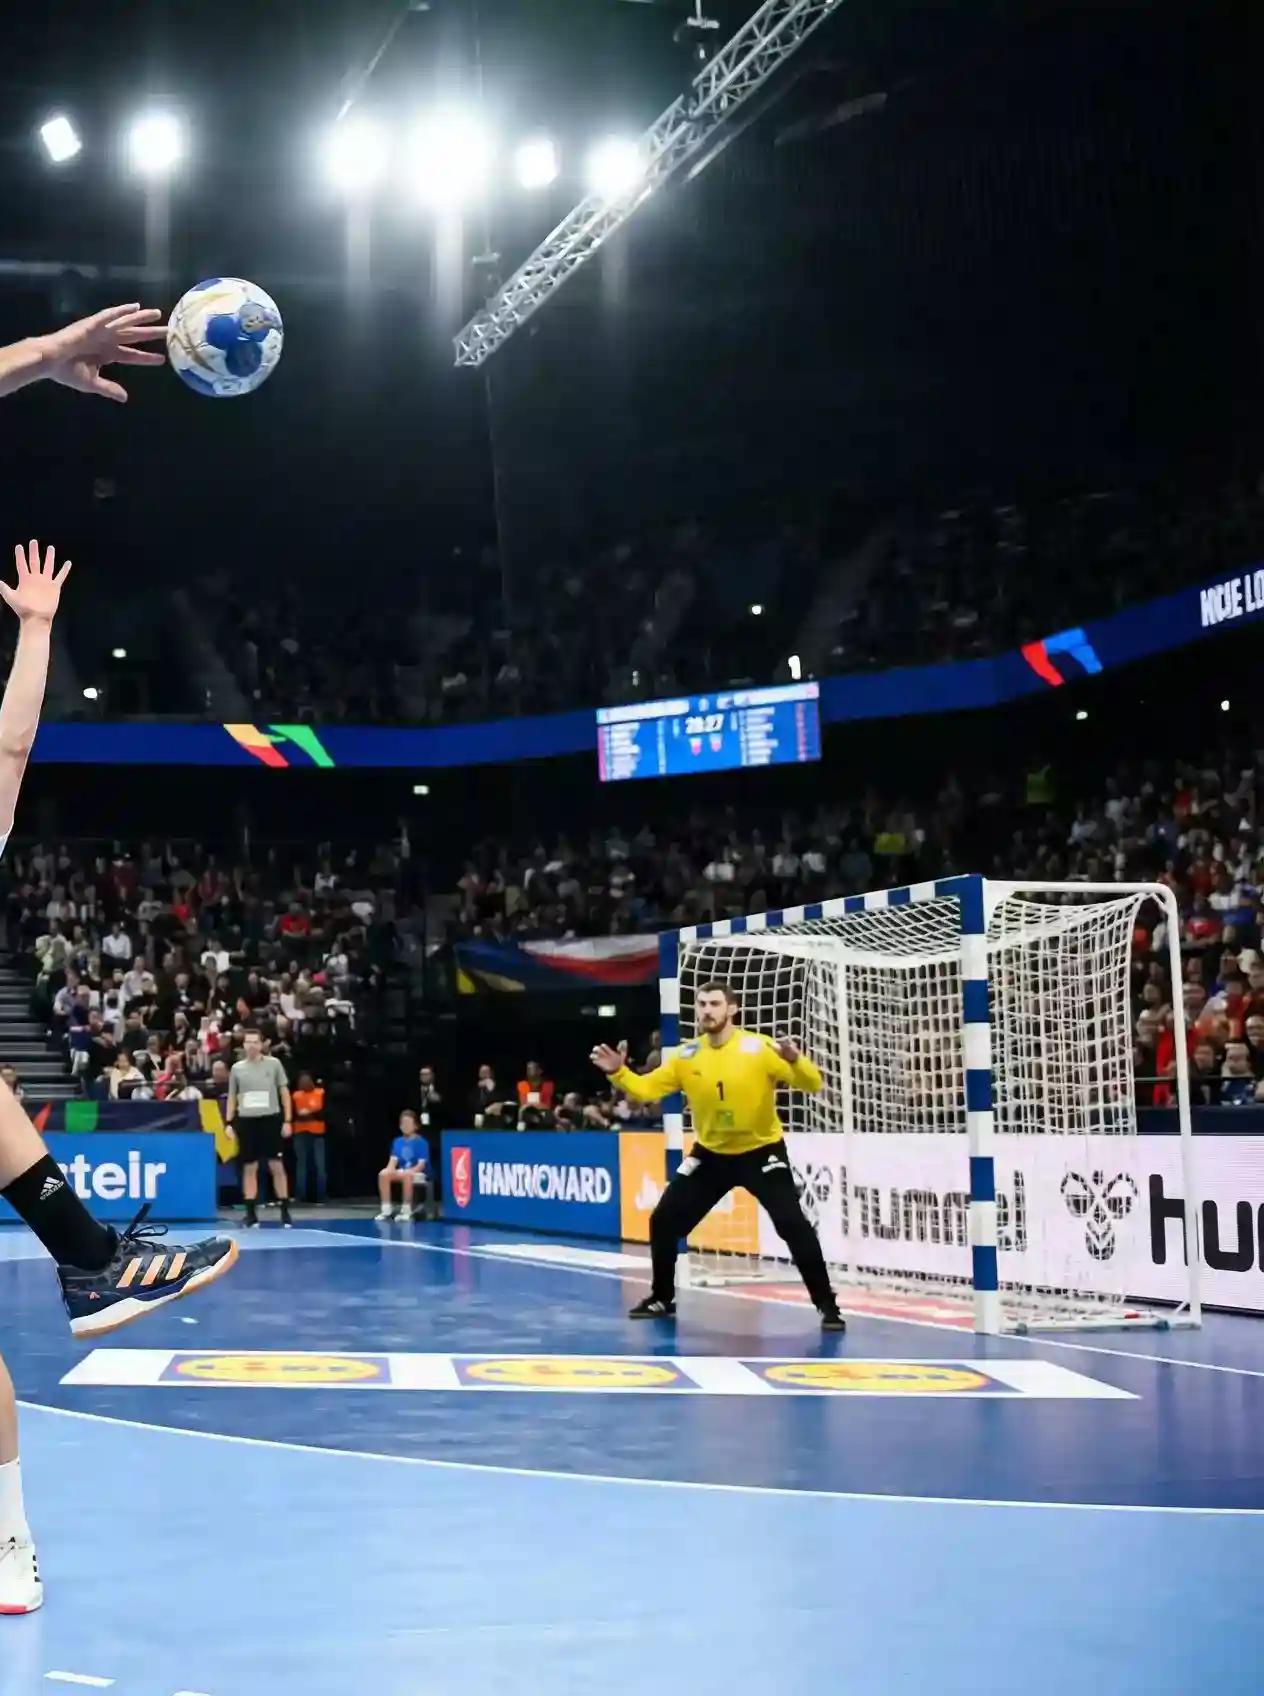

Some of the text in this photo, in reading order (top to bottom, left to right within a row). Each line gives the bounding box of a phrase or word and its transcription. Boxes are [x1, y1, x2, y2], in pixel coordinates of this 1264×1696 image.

[716, 1081, 724, 1101] 1
[57, 1150, 166, 1200] teir
[1148, 1173, 1264, 1273] hu
